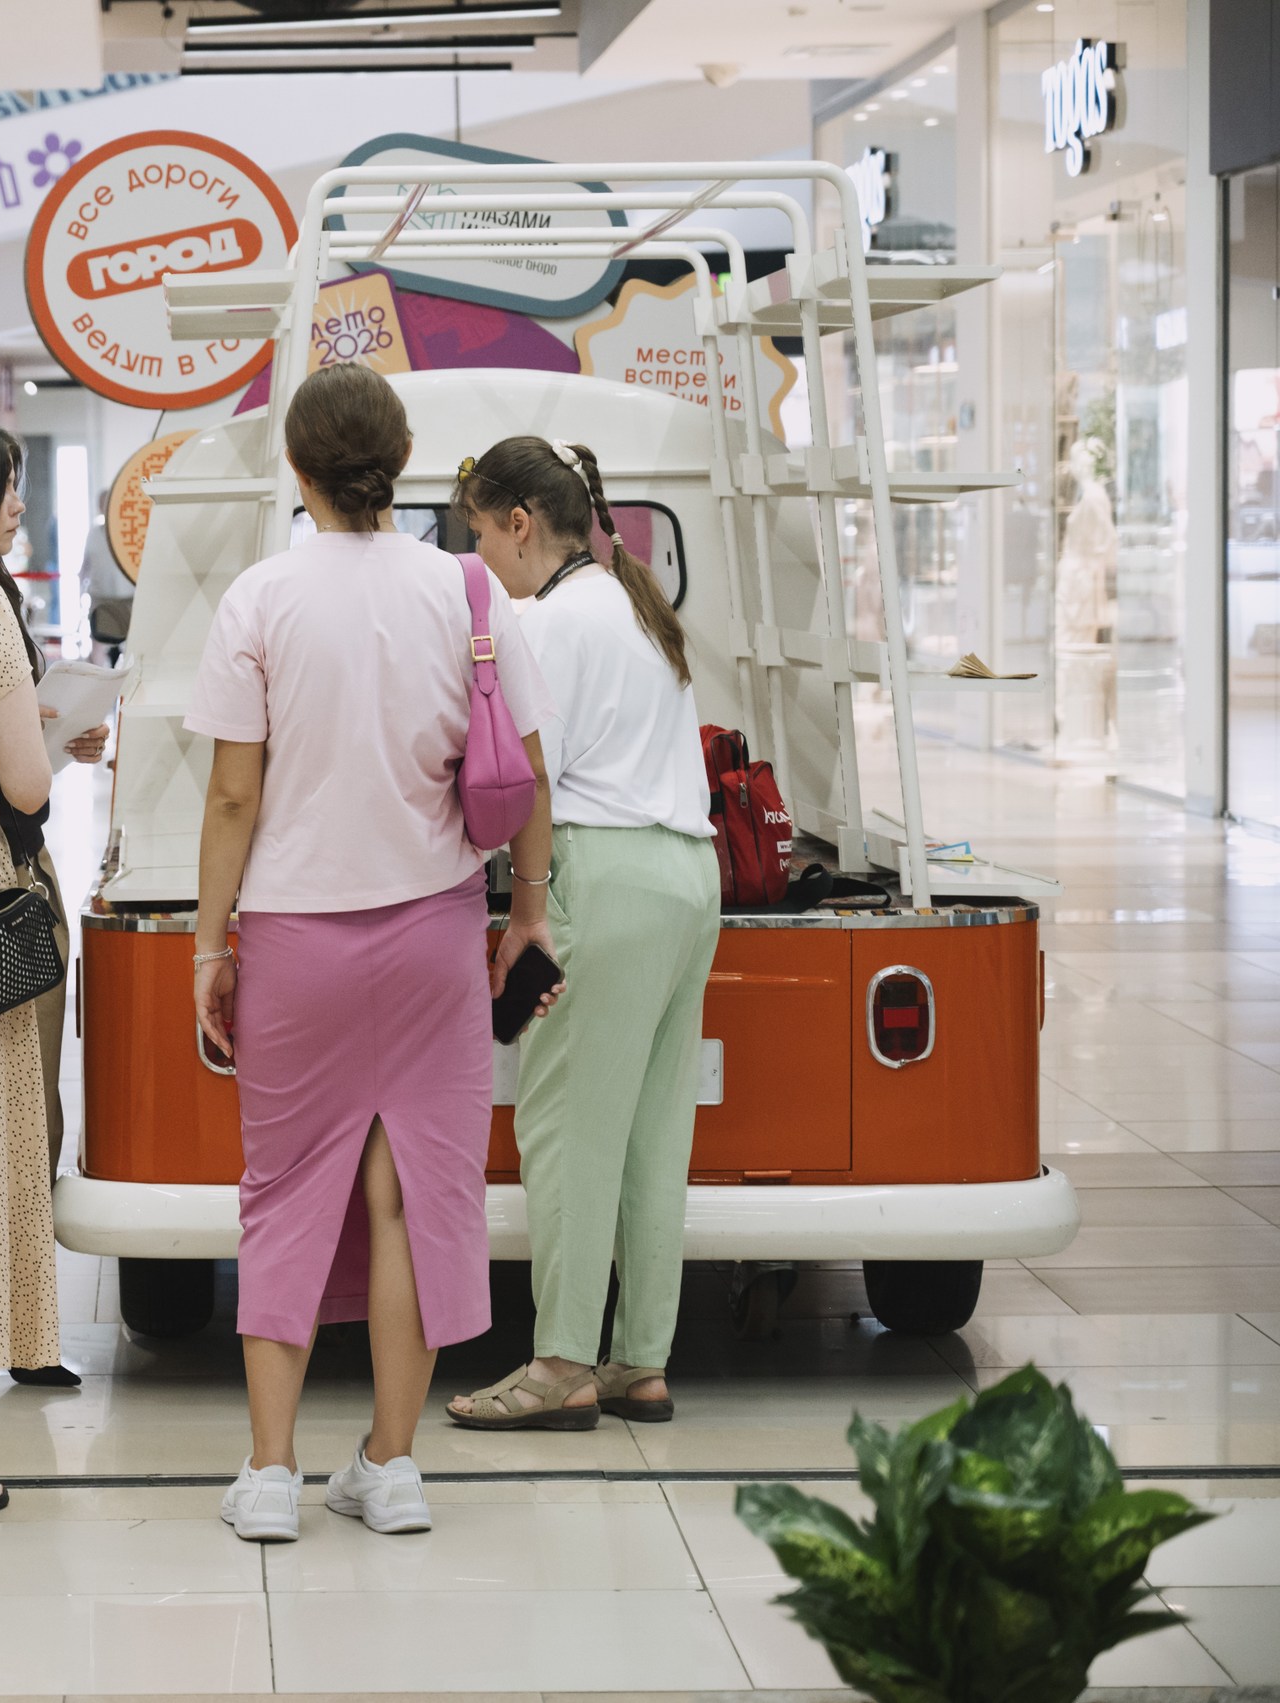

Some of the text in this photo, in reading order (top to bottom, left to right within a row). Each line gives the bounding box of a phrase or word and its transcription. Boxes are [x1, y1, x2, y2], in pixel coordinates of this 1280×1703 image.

[128, 163, 240, 210] дороги
[87, 227, 244, 292] ГОРОД
[72, 312, 162, 378] ведут
[311, 306, 386, 341] лето
[315, 324, 394, 366] 2026
[624, 368, 737, 390] встреи
